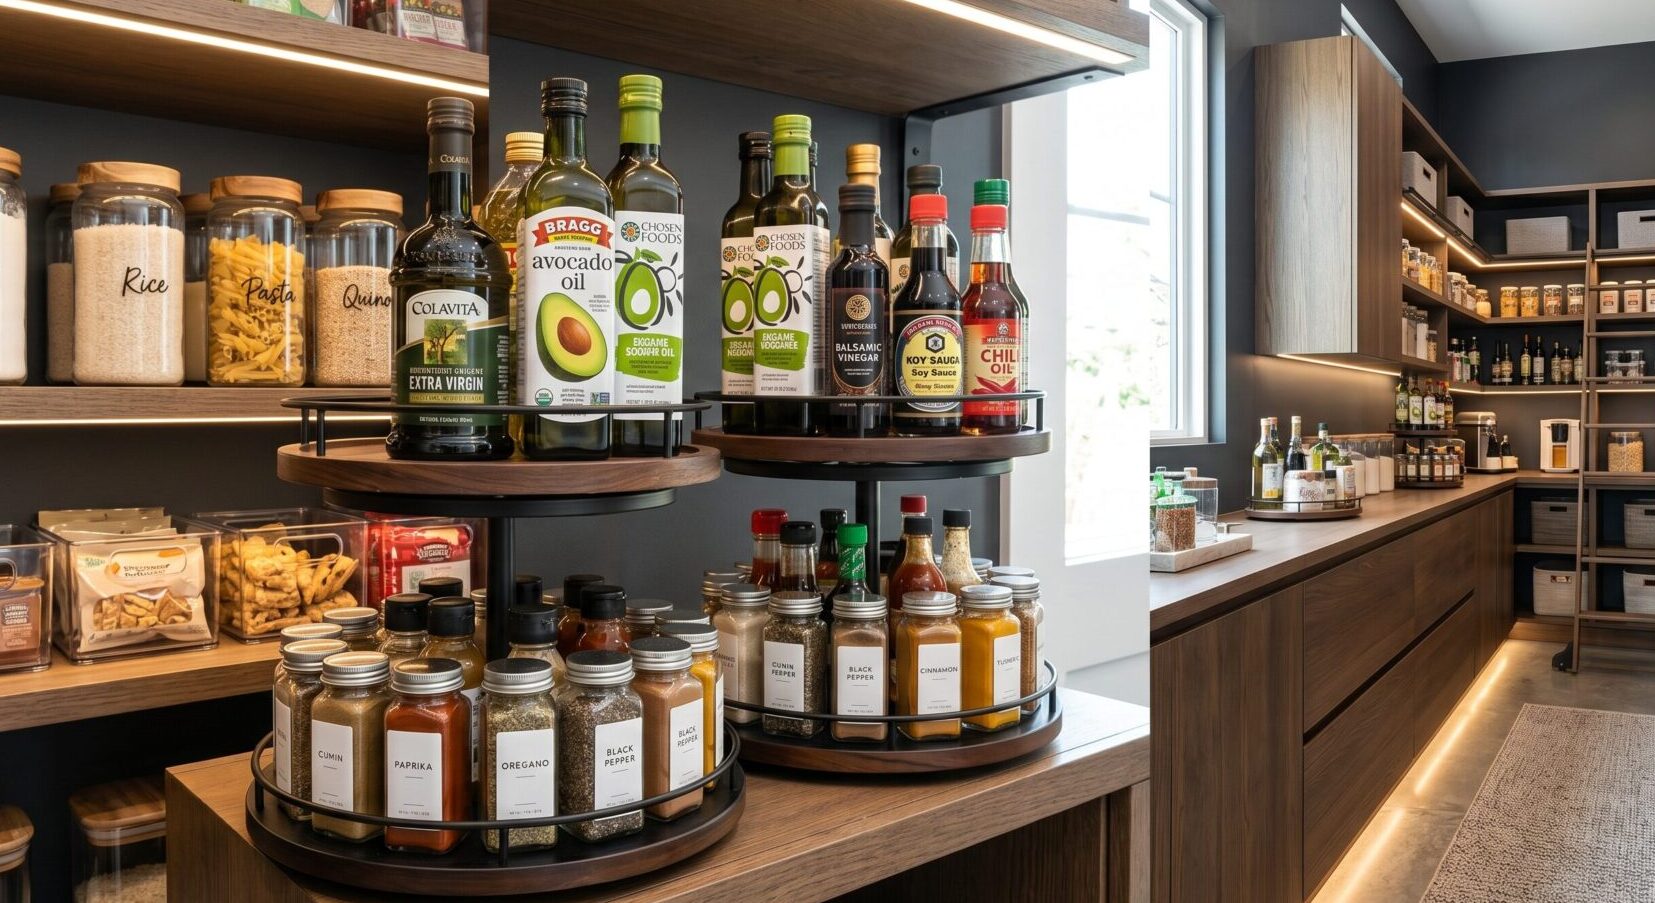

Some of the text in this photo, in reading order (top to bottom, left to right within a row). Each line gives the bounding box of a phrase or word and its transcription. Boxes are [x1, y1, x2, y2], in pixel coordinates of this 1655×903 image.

[544, 219, 602, 235] BRAGG
[641, 221, 682, 232] CHOSEN
[641, 232, 682, 244] FOODS
[770, 232, 805, 241] CHOSEN
[770, 241, 806, 251] FOODS
[532, 253, 613, 271] avocado
[121, 266, 169, 297] Rice
[561, 272, 585, 290] oil
[241, 277, 296, 305] Pasta
[412, 301, 480, 316] COLAVITA
[661, 348, 675, 357] OIL
[835, 343, 882, 352] BALSAMIC
[838, 353, 879, 362] VINEGAR
[906, 356, 927, 365] KOY
[911, 369, 929, 377] Soy
[990, 363, 1013, 374] OIL
[409, 375, 484, 391] EXTRA VIRGIN
[920, 666, 958, 674] CINNAMON
[678, 725, 696, 738] BLACK
[606, 744, 634, 756] BLACK
[318, 750, 343, 762] CUMIN
[604, 755, 636, 767] PEPPER
[394, 760, 433, 771] PAPRIKA
[501, 759, 550, 770] OREGANO
